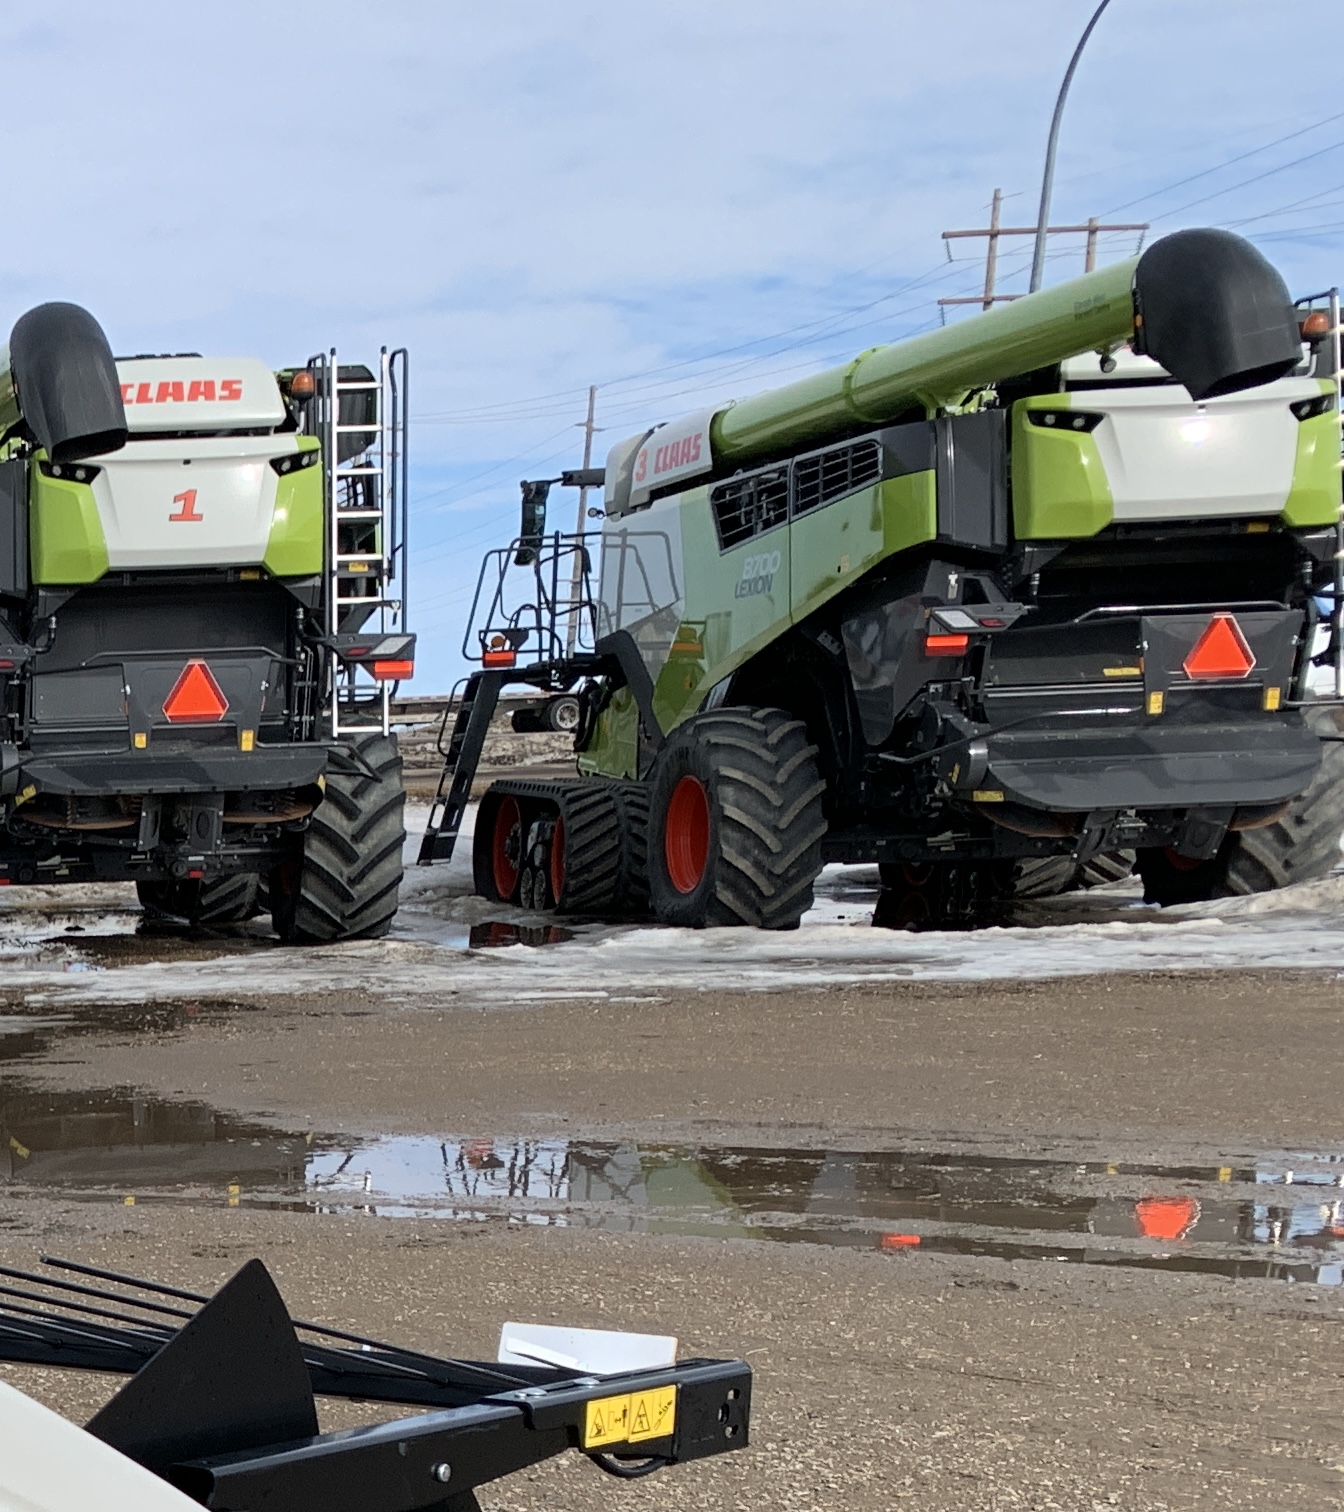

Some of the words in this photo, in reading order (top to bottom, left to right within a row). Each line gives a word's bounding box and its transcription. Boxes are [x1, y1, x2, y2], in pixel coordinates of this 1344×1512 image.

[118, 380, 243, 405] CLAAS
[654, 432, 703, 475] CLAAS
[168, 489, 203, 522] 1
[742, 550, 781, 580] 8700
[734, 574, 774, 599] LEXION
